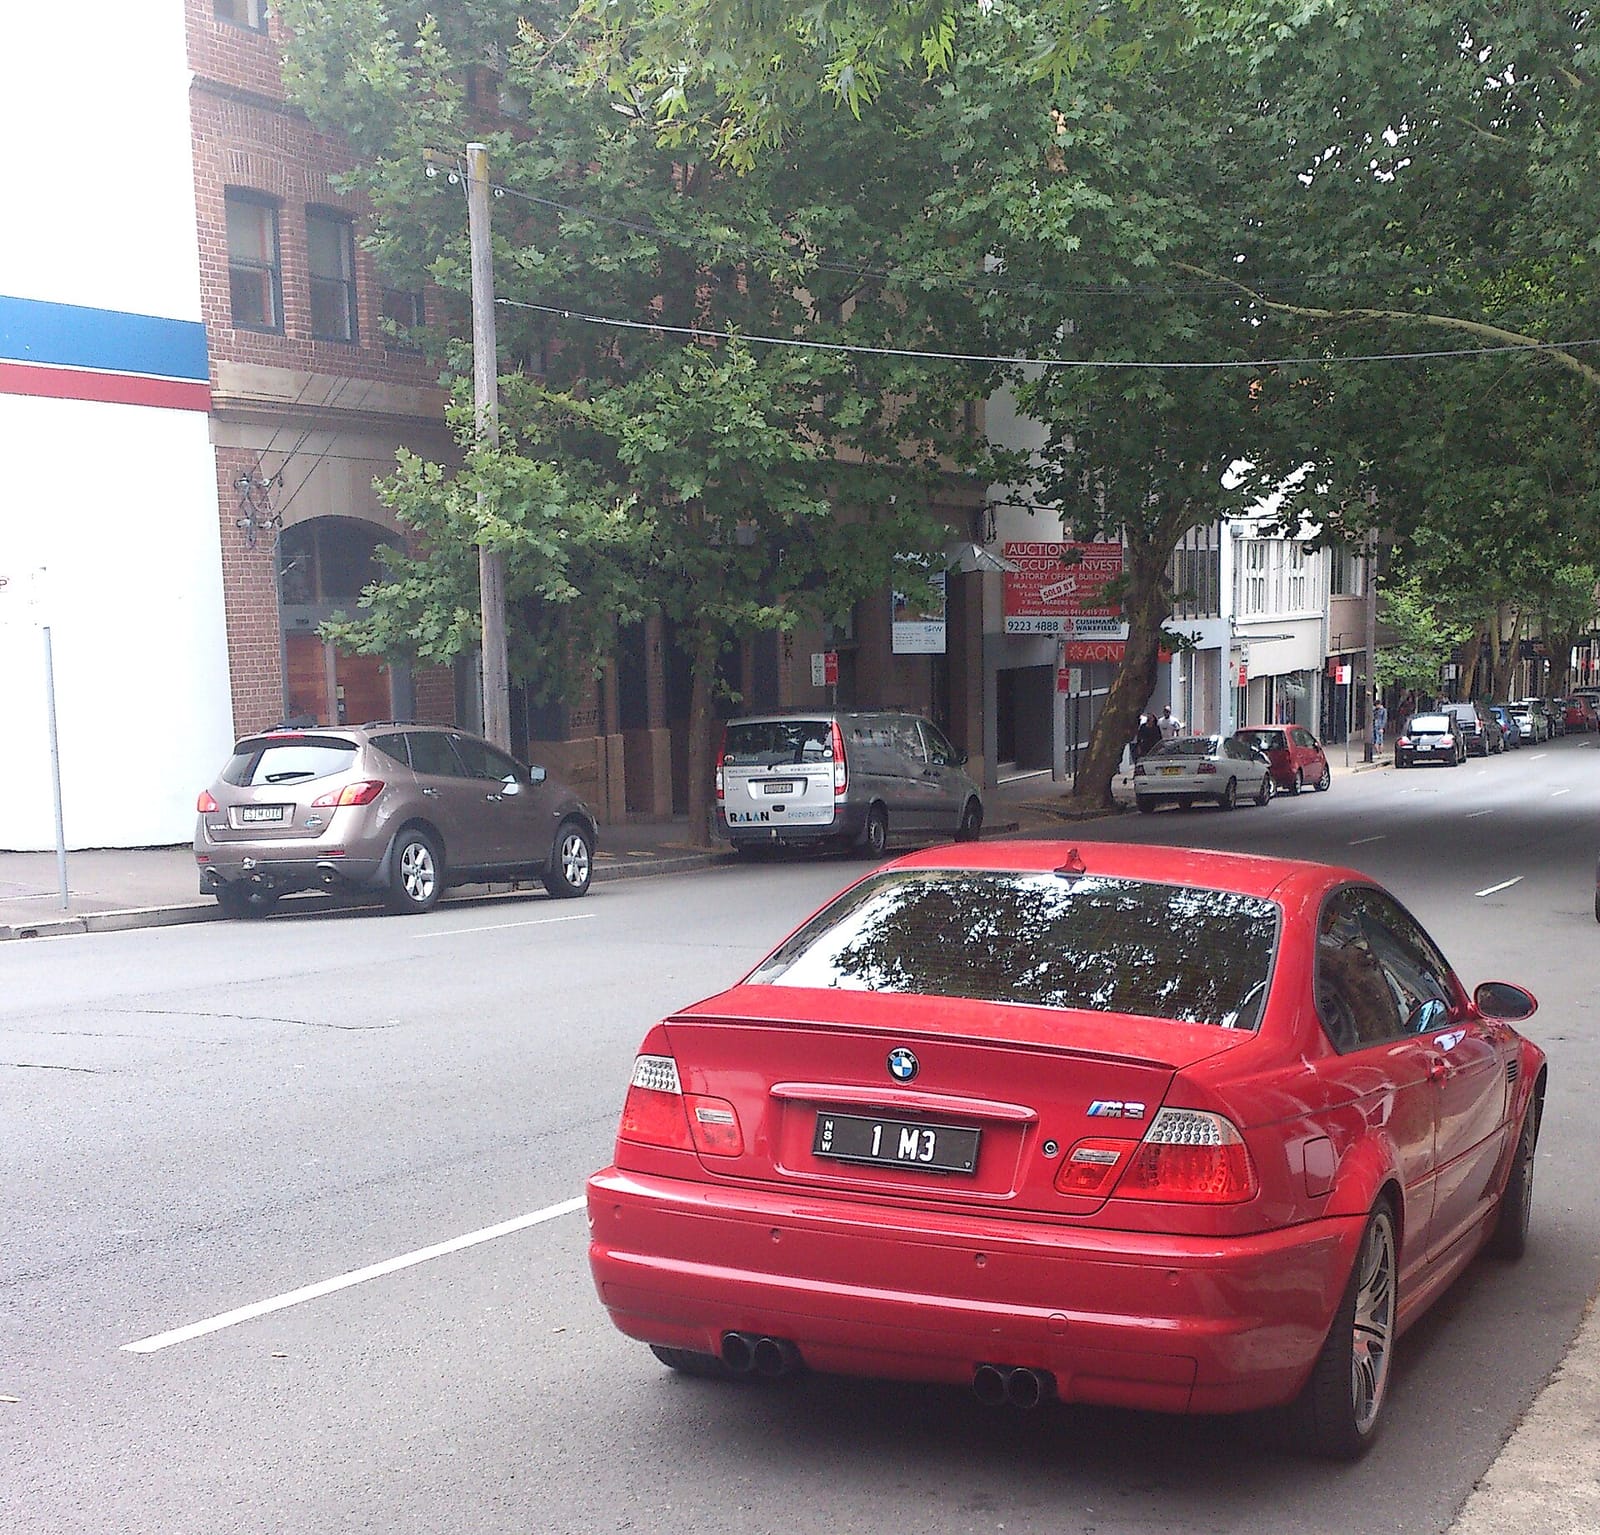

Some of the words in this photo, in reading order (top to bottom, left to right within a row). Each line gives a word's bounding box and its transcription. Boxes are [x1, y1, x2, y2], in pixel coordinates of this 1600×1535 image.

[1008, 543, 1069, 556] AUCTION
[1010, 559, 1060, 571] OCCUPY
[1079, 559, 1120, 571] INVEST
[1078, 572, 1115, 580] BUILDING
[1043, 585, 1062, 599] SOLD
[1063, 581, 1073, 591] BY
[1007, 621, 1031, 631] 9223
[1035, 621, 1059, 631] 4888
[729, 811, 770, 823] RALAN
[1088, 1100, 1146, 1119] M3
[821, 1120, 834, 1152] NSW
[871, 1125, 883, 1156] 1
[898, 1127, 936, 1162] M3
